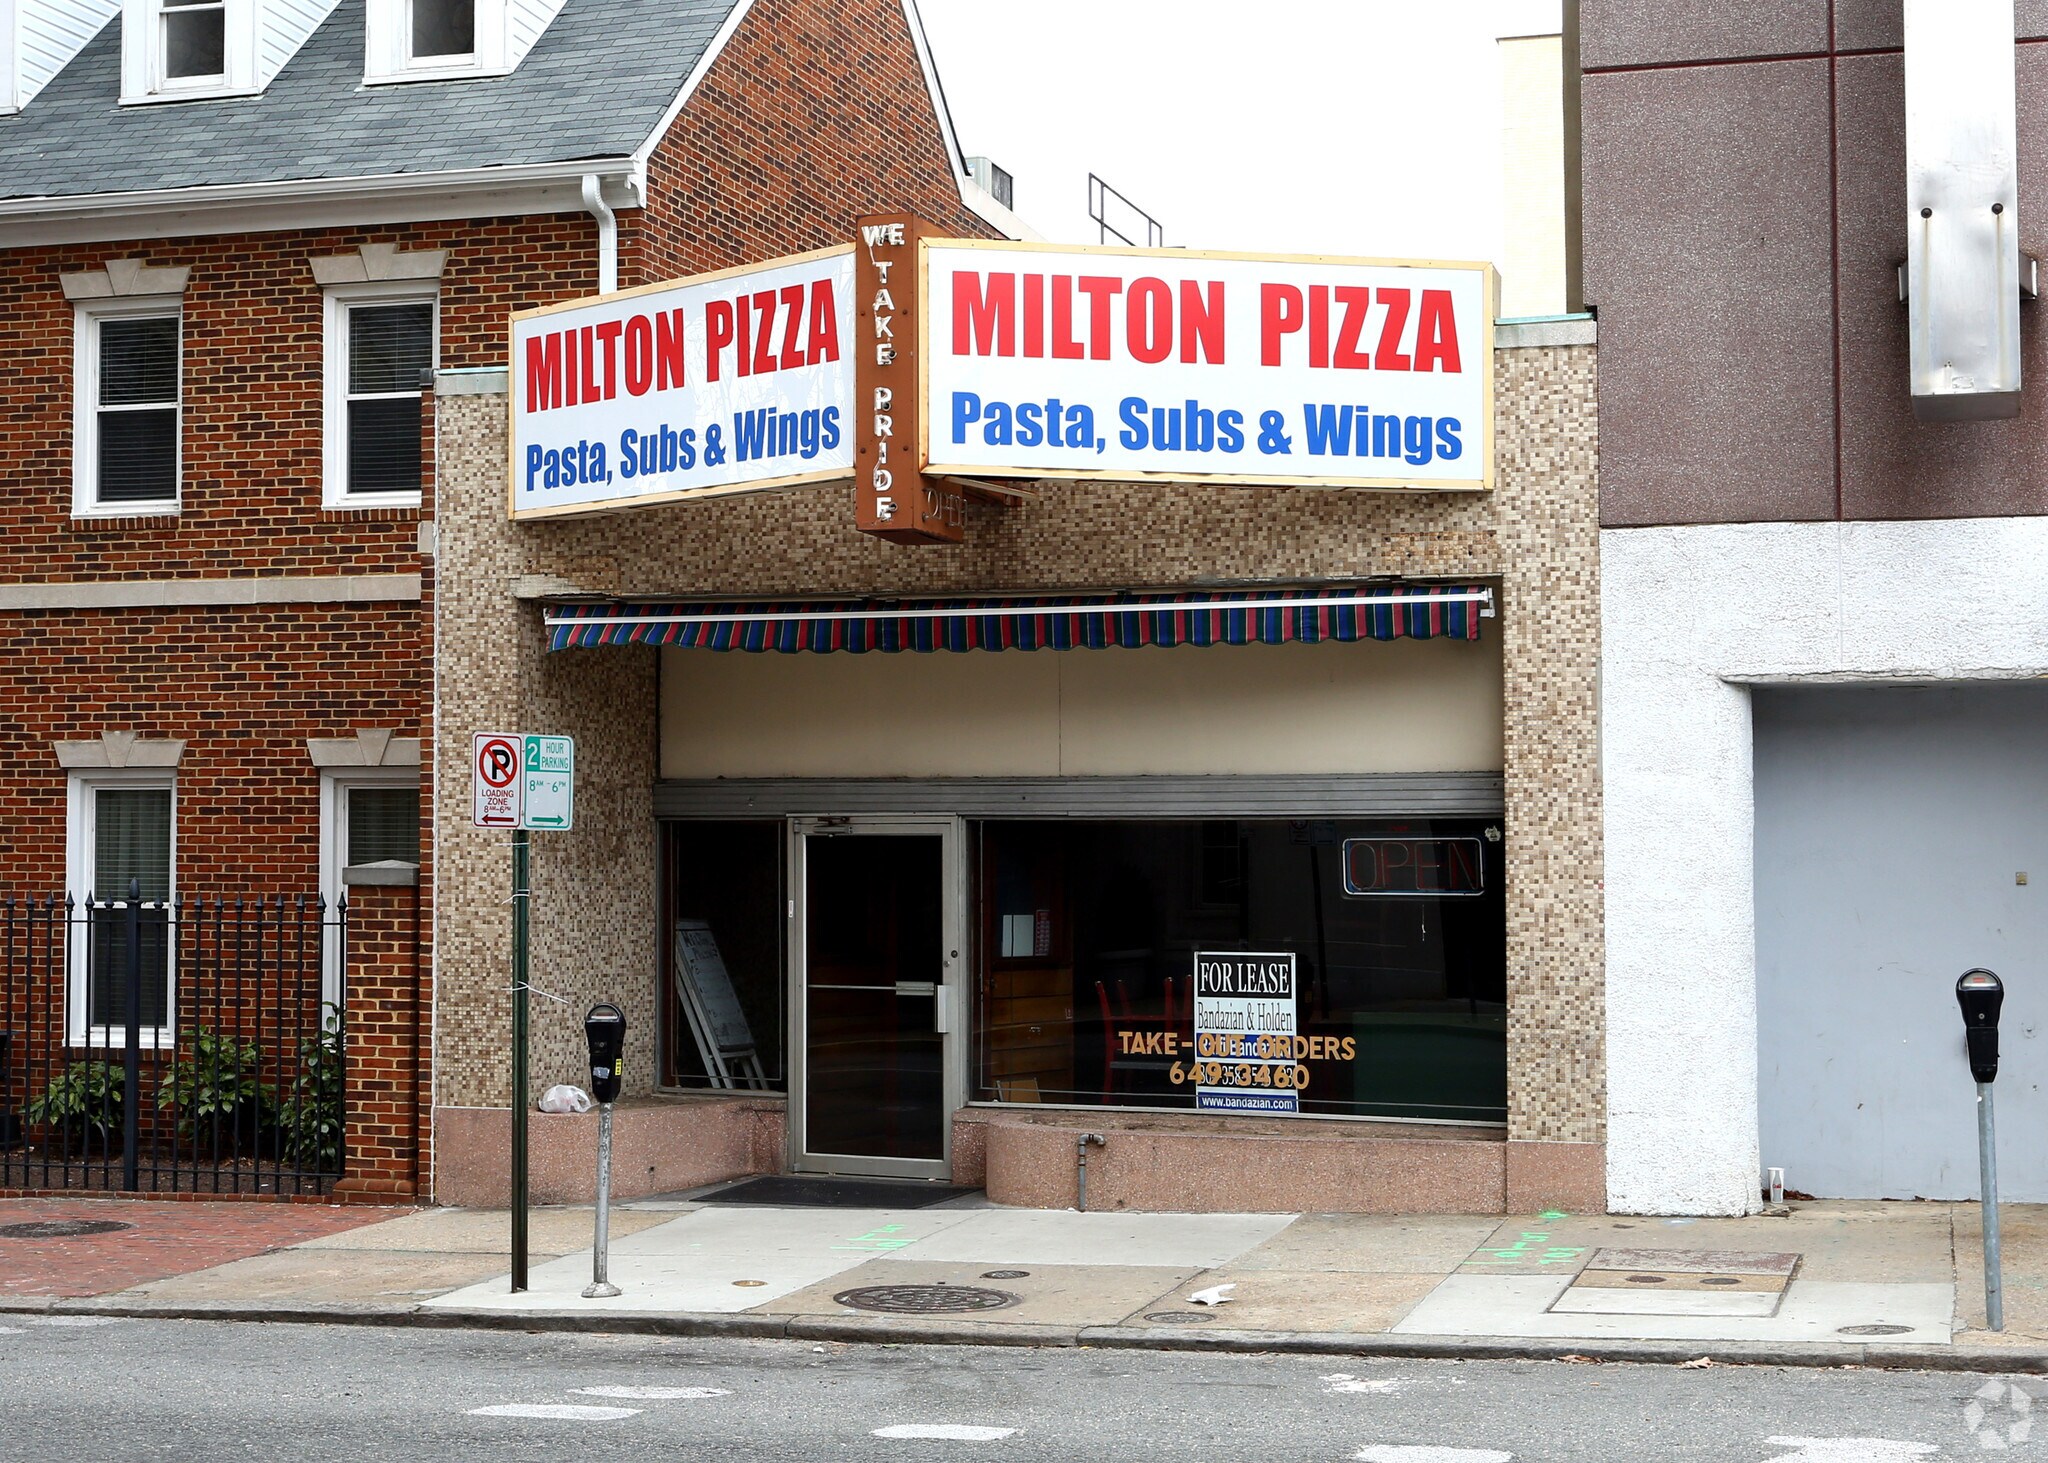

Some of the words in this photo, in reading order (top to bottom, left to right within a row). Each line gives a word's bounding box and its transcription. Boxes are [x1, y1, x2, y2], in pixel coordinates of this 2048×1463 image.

[862, 224, 905, 246] WE
[873, 261, 897, 366] TAKE
[952, 271, 1225, 365] MILTON
[1260, 283, 1462, 373] PIZZA
[526, 307, 685, 413] MILTON
[705, 278, 840, 383] PIZZA
[952, 391, 1106, 455] Pasta,
[1119, 396, 1245, 454] Subs
[1257, 410, 1292, 455] &
[1303, 403, 1463, 466] Wings
[526, 439, 613, 492] Pasta,
[620, 423, 696, 478] Subs
[703, 423, 726, 466] &
[733, 405, 840, 462] Wings
[873, 387, 897, 521] PRIDE
[527, 743, 538, 765] 2
[541, 757, 568, 769] PARKING
[545, 742, 564, 754] HOUR
[481, 789, 514, 798] LOADING
[487, 797, 508, 806] ZONE
[1350, 841, 1480, 891] OPEN
[1200, 962, 1233, 993] FOR
[1236, 962, 1290, 994] LEASE
[1198, 1001, 1244, 1031] Bandazian
[1246, 1002, 1255, 1031] &
[1257, 1002, 1293, 1032] Holden
[1257, 1034, 1357, 1061] ORDERS
[1169, 1061, 1310, 1090] 649-3460
[1201, 1096, 1293, 1110] www.bandazian.com
